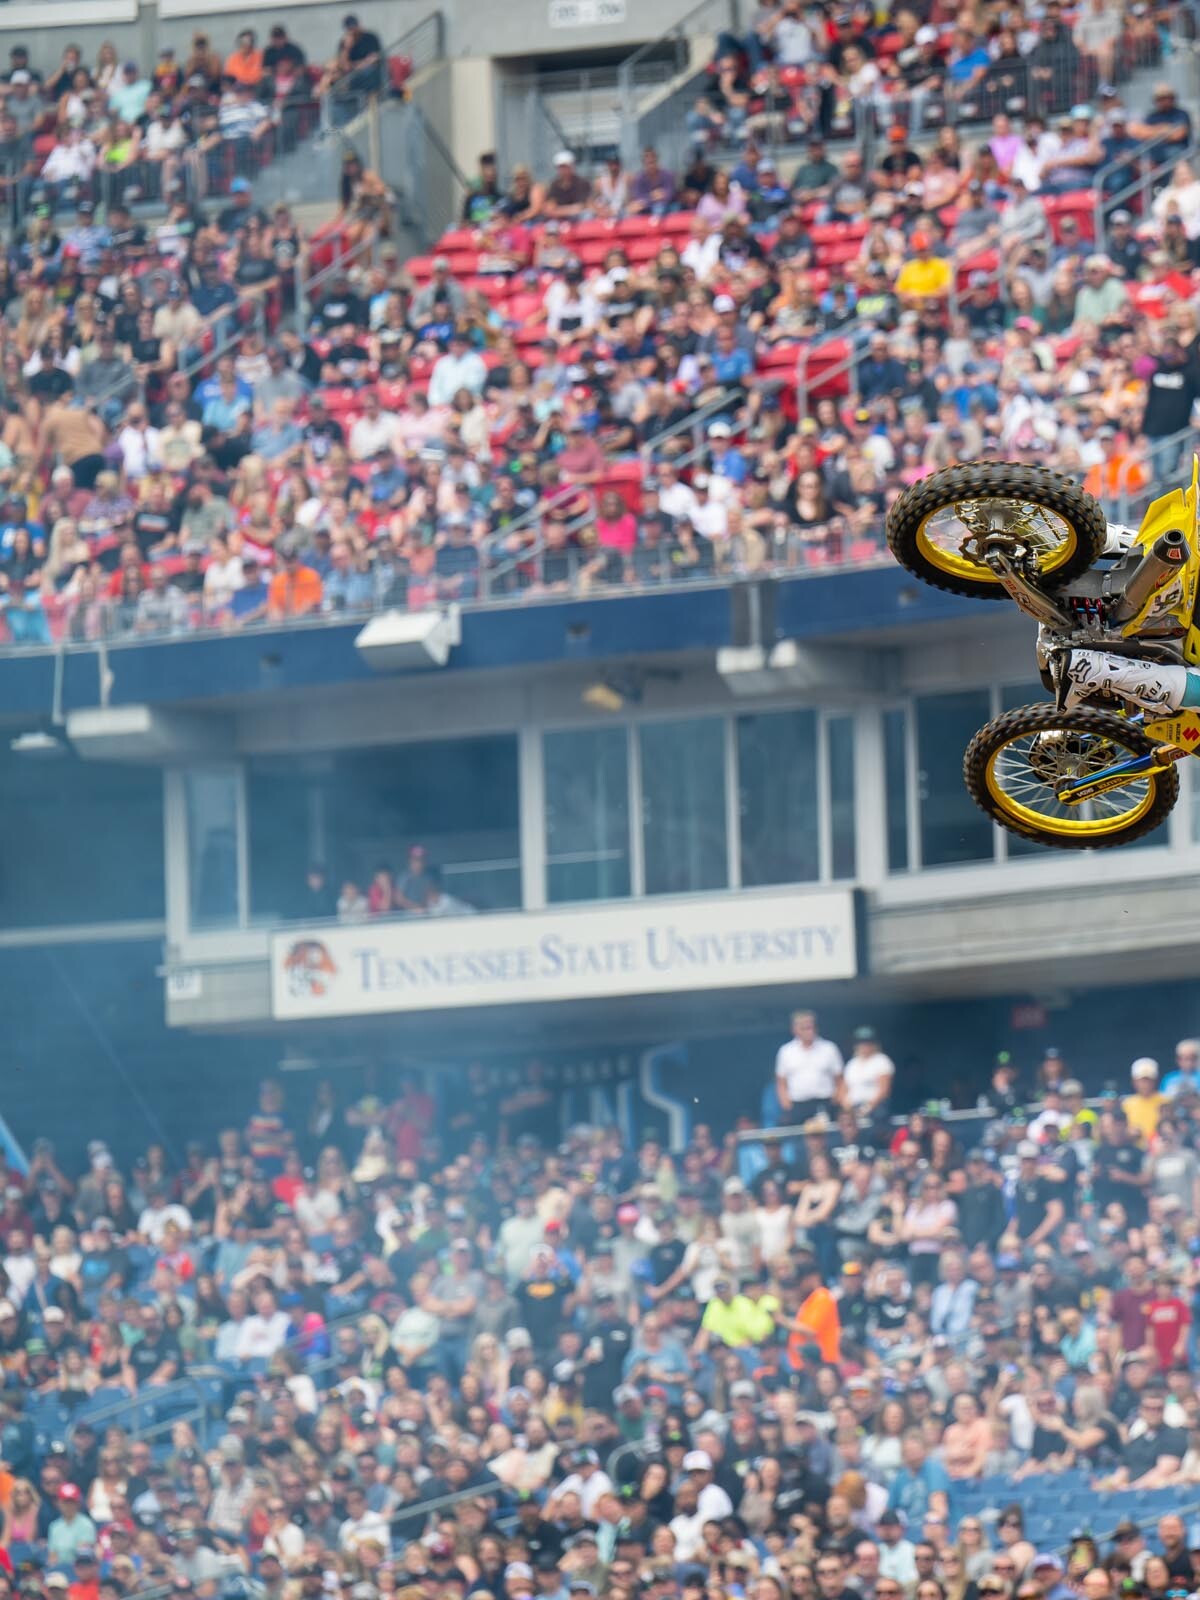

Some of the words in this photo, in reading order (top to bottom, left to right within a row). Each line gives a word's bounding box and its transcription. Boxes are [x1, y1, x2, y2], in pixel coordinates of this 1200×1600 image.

[353, 947, 532, 991] TENNESSEE
[541, 934, 634, 976] STATE
[646, 923, 840, 973] UNIVERSITY
